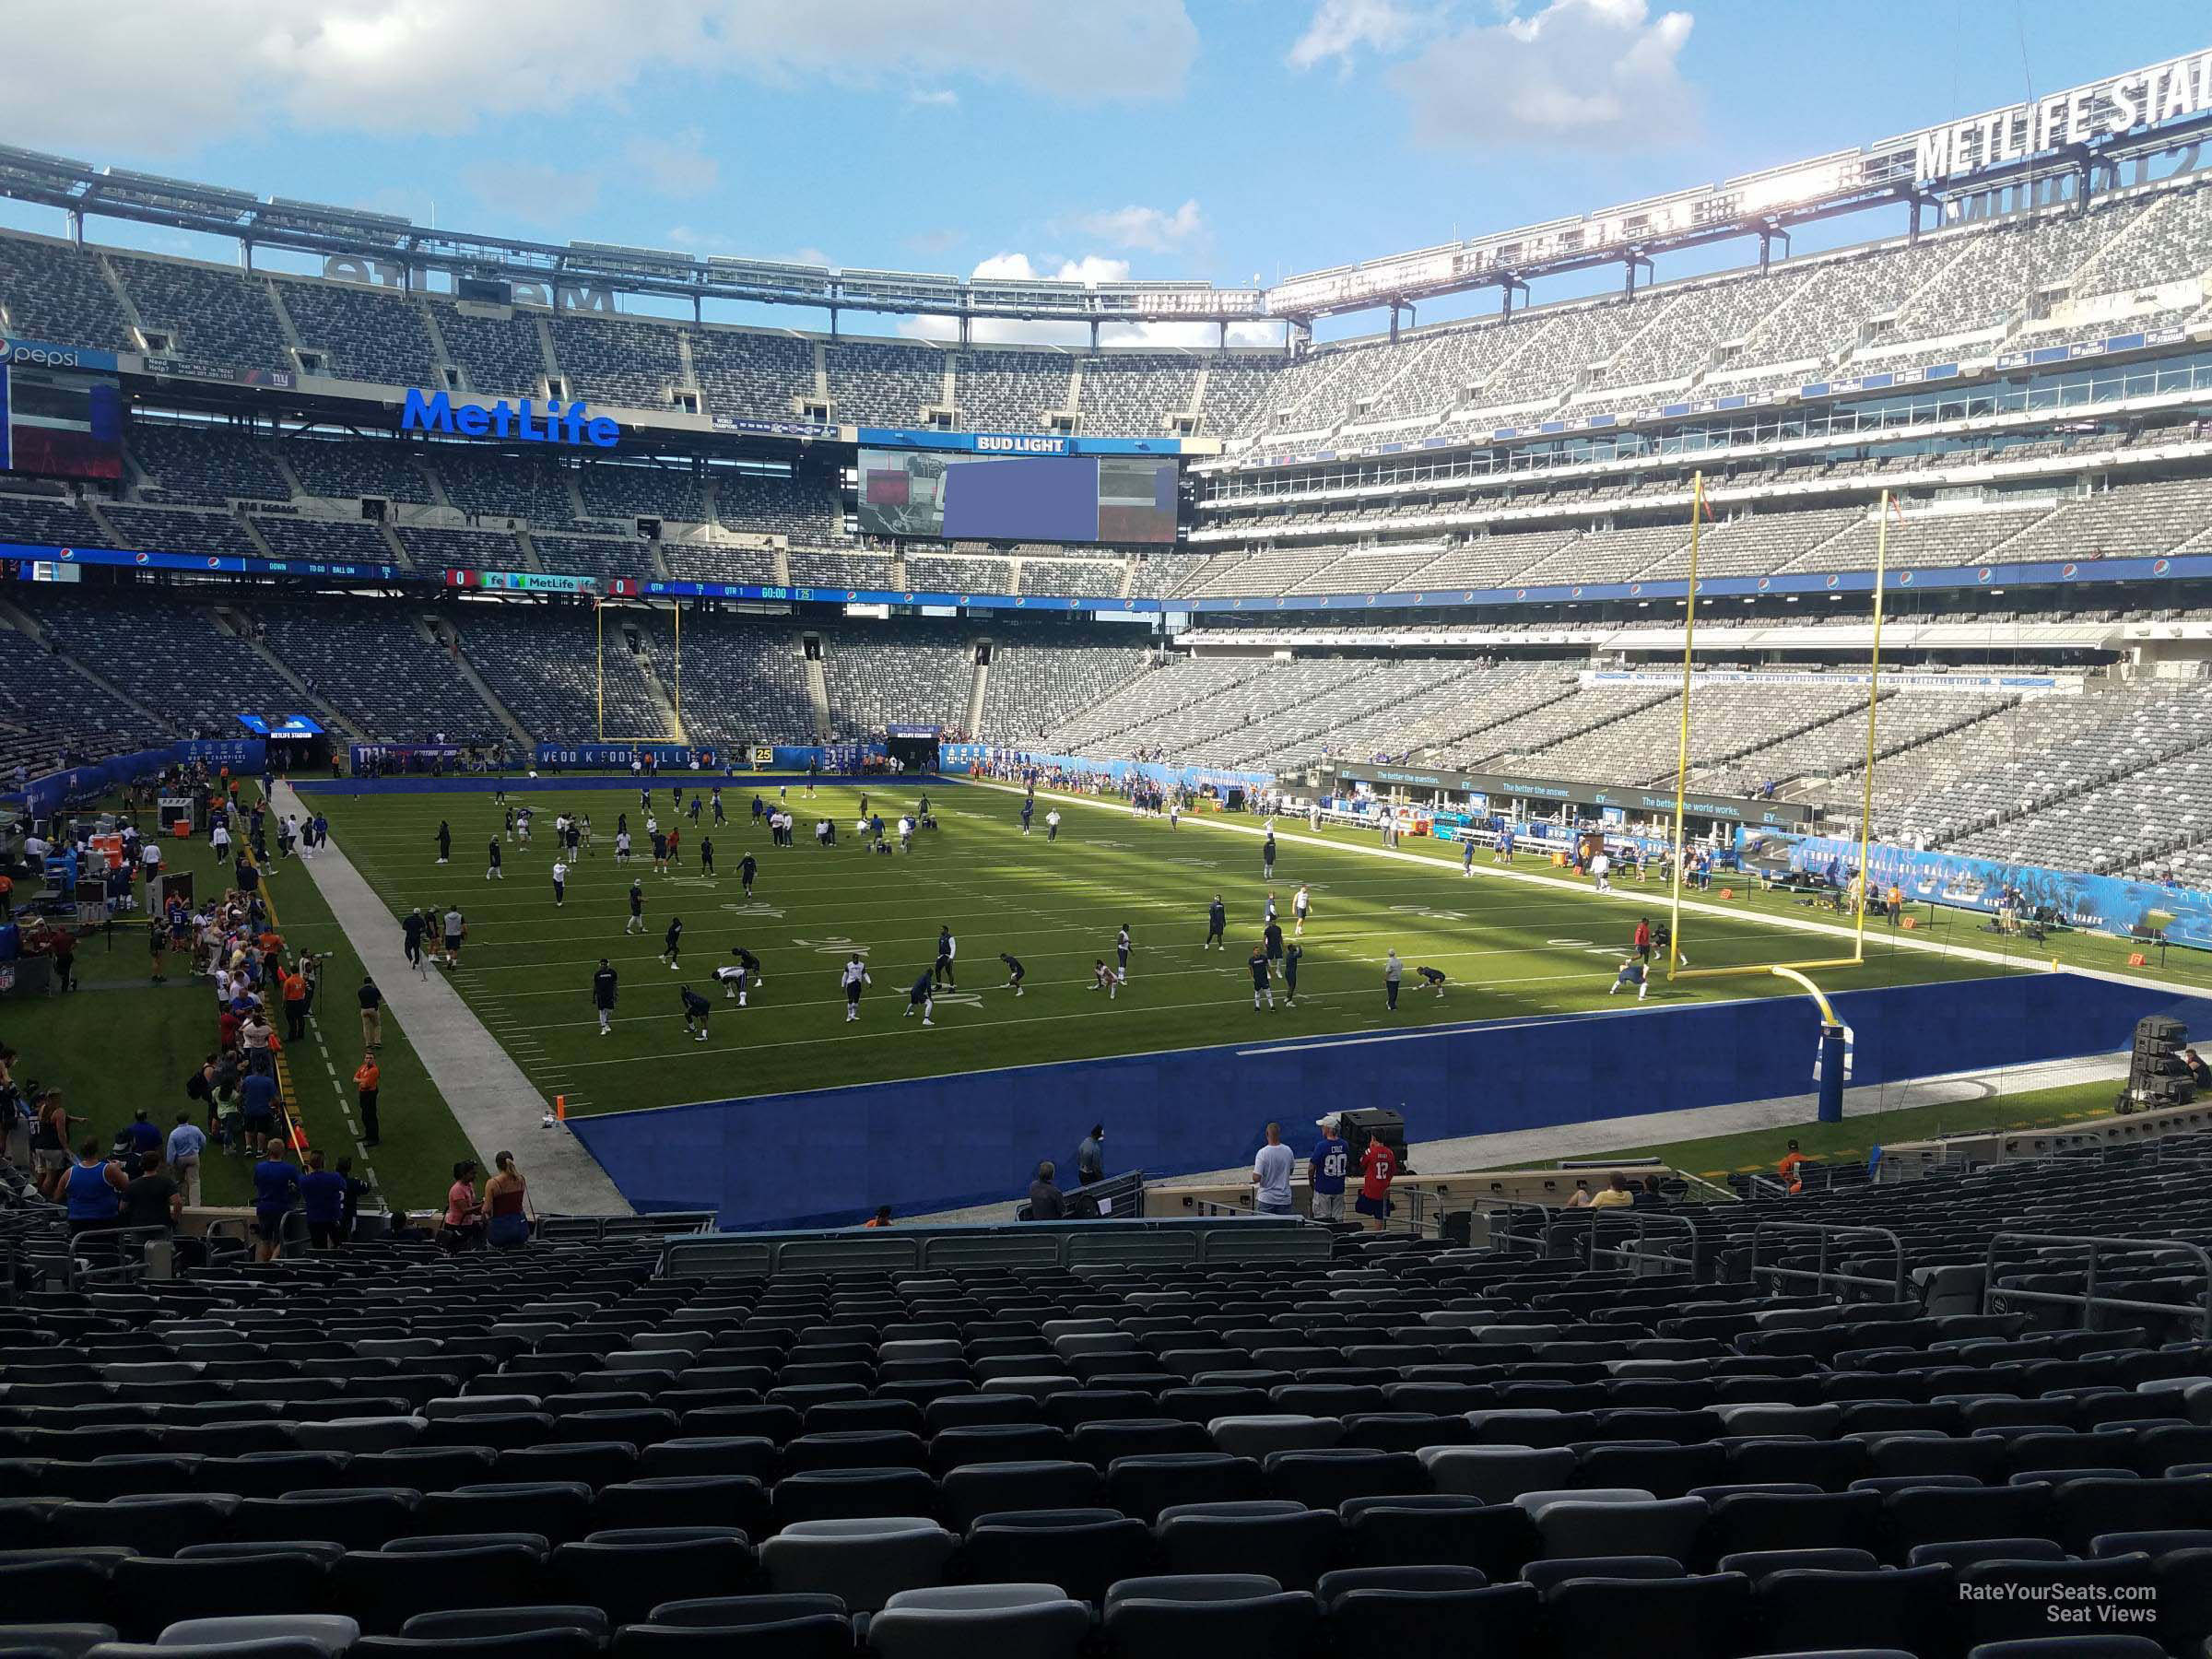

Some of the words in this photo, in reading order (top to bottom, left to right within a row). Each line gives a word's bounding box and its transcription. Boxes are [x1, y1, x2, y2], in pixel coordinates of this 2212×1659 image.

[1915, 86, 2094, 182] METLIFE
[14, 347, 79, 368] pepsi
[148, 358, 167, 366] Need
[148, 364, 170, 372] Help?
[401, 388, 620, 447] MetLife
[977, 436, 1014, 450] BUD
[1015, 438, 1064, 453] LIGHT
[269, 562, 287, 571] DOWN
[332, 566, 346, 574] BALL
[456, 571, 465, 584] 0
[529, 577, 574, 589] MetLife
[616, 580, 624, 593] 0
[724, 586, 737, 595] QTR
[800, 589, 810, 599] 25
[756, 748, 771, 759] 25
[1341, 771, 1350, 779] EY
[1377, 771, 1387, 780] The
[1387, 772, 1405, 781] better
[1405, 773, 1414, 782] the
[1415, 775, 1440, 784] question.
[1461, 781, 1471, 790] EY
[1502, 782, 1514, 792] The
[1514, 783, 1534, 793] better
[1535, 785, 1545, 794] the
[1546, 788, 1571, 797] answer.
[1595, 794, 1606, 804] EY
[1641, 796, 1654, 806] The
[1655, 798, 1677, 808] better
[1693, 803, 1713, 813] world
[1714, 805, 1740, 816] works.
[1763, 812, 1776, 823] EY
[1324, 1153, 1347, 1178] 80
[1375, 1161, 1389, 1180] 12
